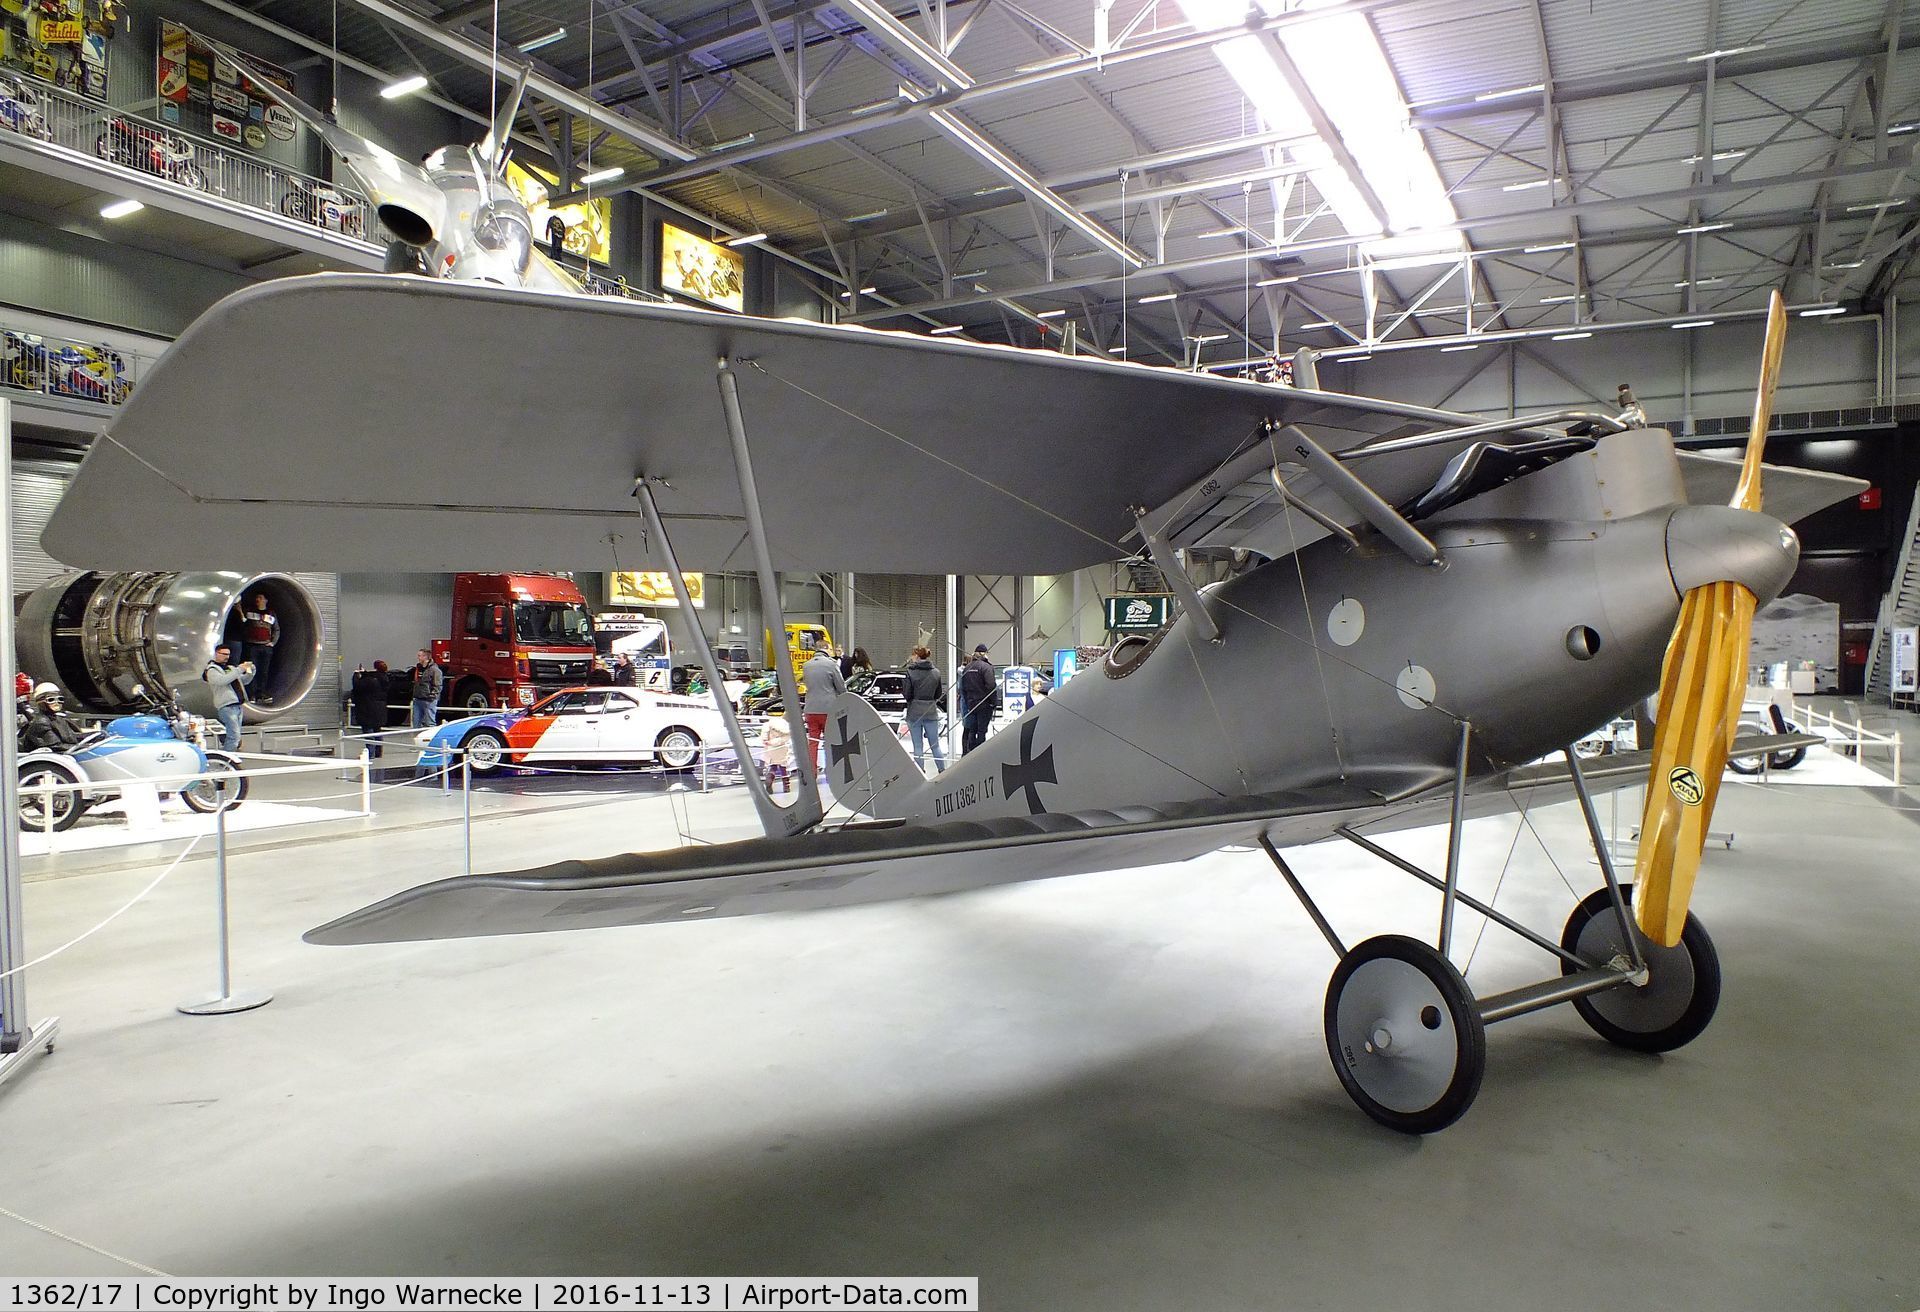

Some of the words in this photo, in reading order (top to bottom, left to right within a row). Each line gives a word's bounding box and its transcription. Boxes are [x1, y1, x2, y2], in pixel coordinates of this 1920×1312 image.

[43, 23, 80, 39] Fulda
[1295, 445, 1310, 459] R
[1200, 479, 1221, 497] 1362
[649, 671, 661, 685] 6
[935, 798, 942, 817] D
[943, 793, 954, 814] III
[956, 784, 976, 810] 1362
[984, 776, 994, 798] 17
[1344, 1045, 1357, 1068] 1362
